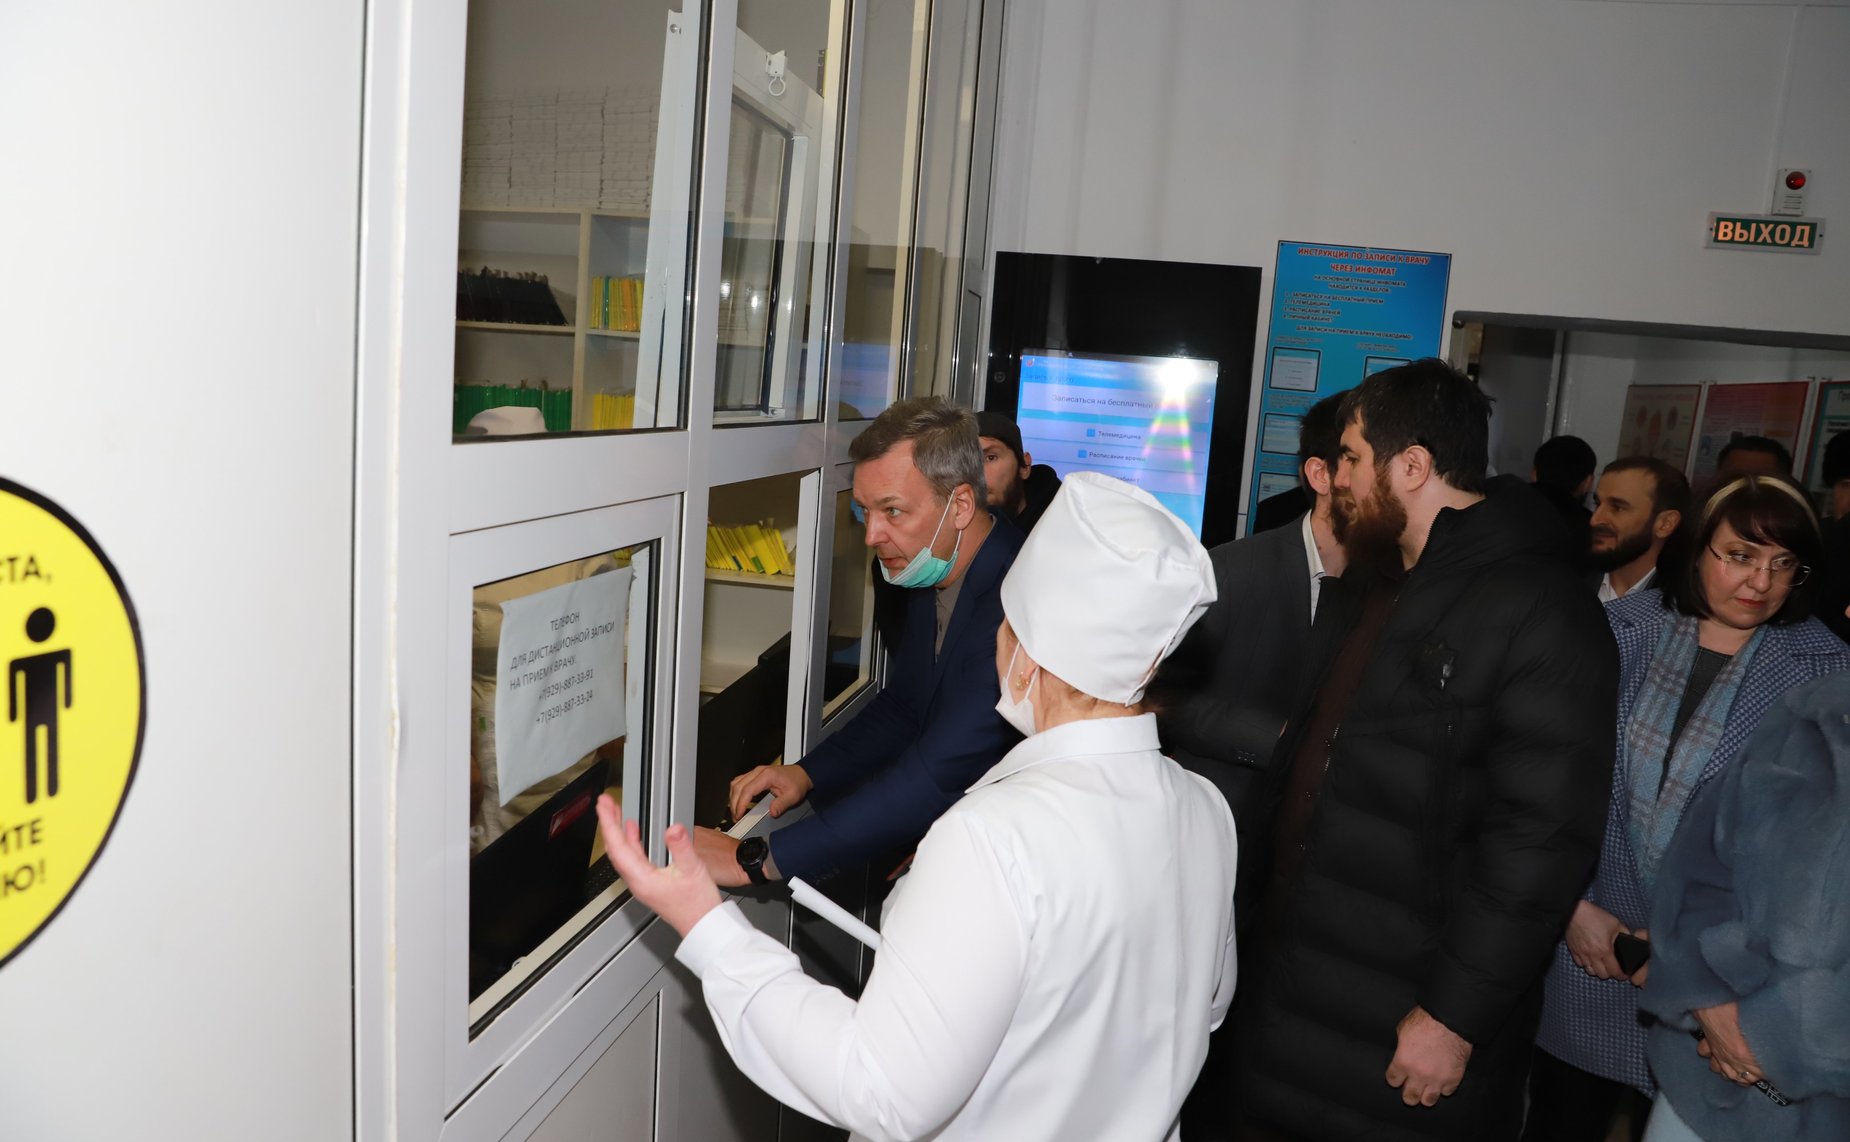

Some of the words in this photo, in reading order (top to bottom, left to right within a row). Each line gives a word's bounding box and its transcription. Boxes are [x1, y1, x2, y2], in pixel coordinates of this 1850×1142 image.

[1717, 221, 1811, 247] ВЫХОД
[1298, 248, 1349, 259] ИНСТРУКЦИЯ
[1351, 251, 1363, 260] ПО
[1365, 252, 1397, 263] ЗАПИСИ
[1398, 255, 1404, 263] К
[1405, 256, 1429, 264] ВРАЧУ
[1330, 263, 1353, 272] ЧЕРЕЗ
[1355, 265, 1396, 276] ИНФОМАТ
[1053, 393, 1096, 405] Записаться
[1107, 398, 1153, 409] бесплатный
[550, 612, 580, 631] ТЕЛЕФОН
[510, 655, 527, 671] ДЛЯ
[528, 628, 590, 663] ДИСТАНЦИОННОЙ
[591, 621, 615, 639] ЗАПИСИ
[510, 676, 521, 690] НА
[523, 667, 549, 686] ПРИЕМ
